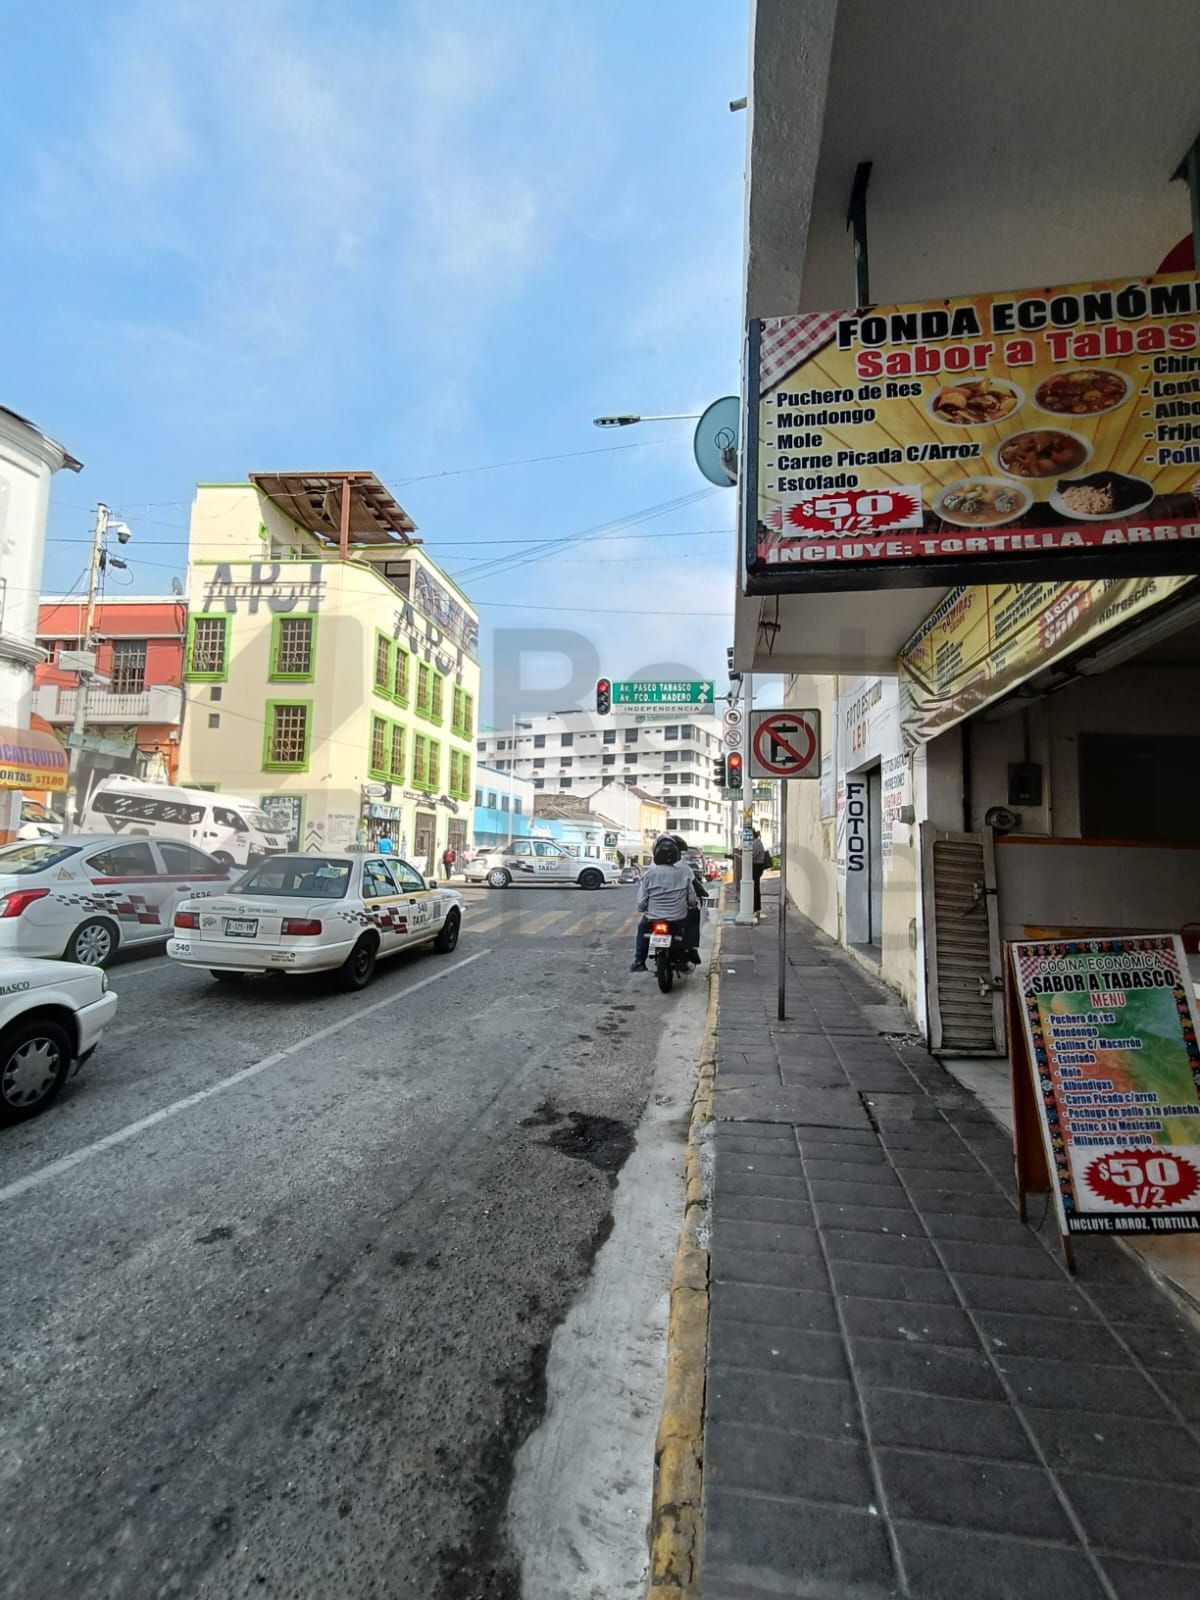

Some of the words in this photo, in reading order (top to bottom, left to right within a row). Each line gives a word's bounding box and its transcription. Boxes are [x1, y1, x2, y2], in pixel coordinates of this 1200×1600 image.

[838, 307, 981, 348] FONDA
[856, 343, 993, 379] Sabor
[1006, 339, 1035, 365] a
[777, 388, 854, 407] Puchero
[858, 384, 882, 400] de
[886, 382, 922, 399] Res
[777, 408, 876, 428] Mondongo
[777, 433, 823, 449] Mole
[778, 454, 833, 470] Carne
[837, 448, 903, 467] Picada
[907, 443, 980, 462] C/Arroz
[778, 474, 859, 492] Estofado
[802, 495, 894, 519] $50
[830, 515, 874, 531] 1/2
[768, 541, 912, 564] INCLUYE:
[1101, 524, 1200, 545] ARRO
[633, 683, 657, 692] PASEO
[660, 683, 692, 692] TABASCO
[634, 693, 651, 702] FCO.
[661, 693, 691, 702] MADERO
[846, 783, 865, 872] FOTOS
[175, 943, 190, 952] 540
[1039, 958, 1087, 973] COCINA
[1088, 953, 1163, 970] ECONÓMICA
[1032, 974, 1085, 994] SABOR
[1088, 973, 1100, 991] A
[1102, 970, 1176, 990] TABASCO
[1091, 993, 1126, 1007] MENU
[1050, 1014, 1086, 1025] Puchero
[1087, 1013, 1098, 1023] de
[1053, 1028, 1098, 1038] Mondongo
[1055, 1040, 1086, 1051] Gallina
[1099, 1037, 1141, 1049] Macarrón
[1058, 1053, 1095, 1064] Estofado
[1060, 1067, 1082, 1077] Mole
[1065, 1095, 1092, 1104] Carne
[1093, 1093, 1124, 1103] Picada
[1125, 1092, 1158, 1102] c/arroz
[1068, 1108, 1107, 1118] Pechuga
[1108, 1107, 1119, 1117] de
[1120, 1107, 1144, 1117] pollo
[1145, 1107, 1152, 1116] a
[1152, 1106, 1162, 1115] la
[1163, 1105, 1199, 1116] plancha
[1071, 1122, 1100, 1132] Bistec
[1101, 1123, 1107, 1131] a
[1109, 1121, 1118, 1131] la
[1119, 1120, 1162, 1131] Mexicana
[1074, 1135, 1115, 1146] Milanesa
[1116, 1135, 1127, 1145] de
[1128, 1134, 1152, 1146] pollo
[1098, 1158, 1180, 1187] $50
[1126, 1186, 1166, 1204] 1/2
[1070, 1218, 1114, 1231] INCLUYE:
[1115, 1217, 1151, 1231] ARROZ,
